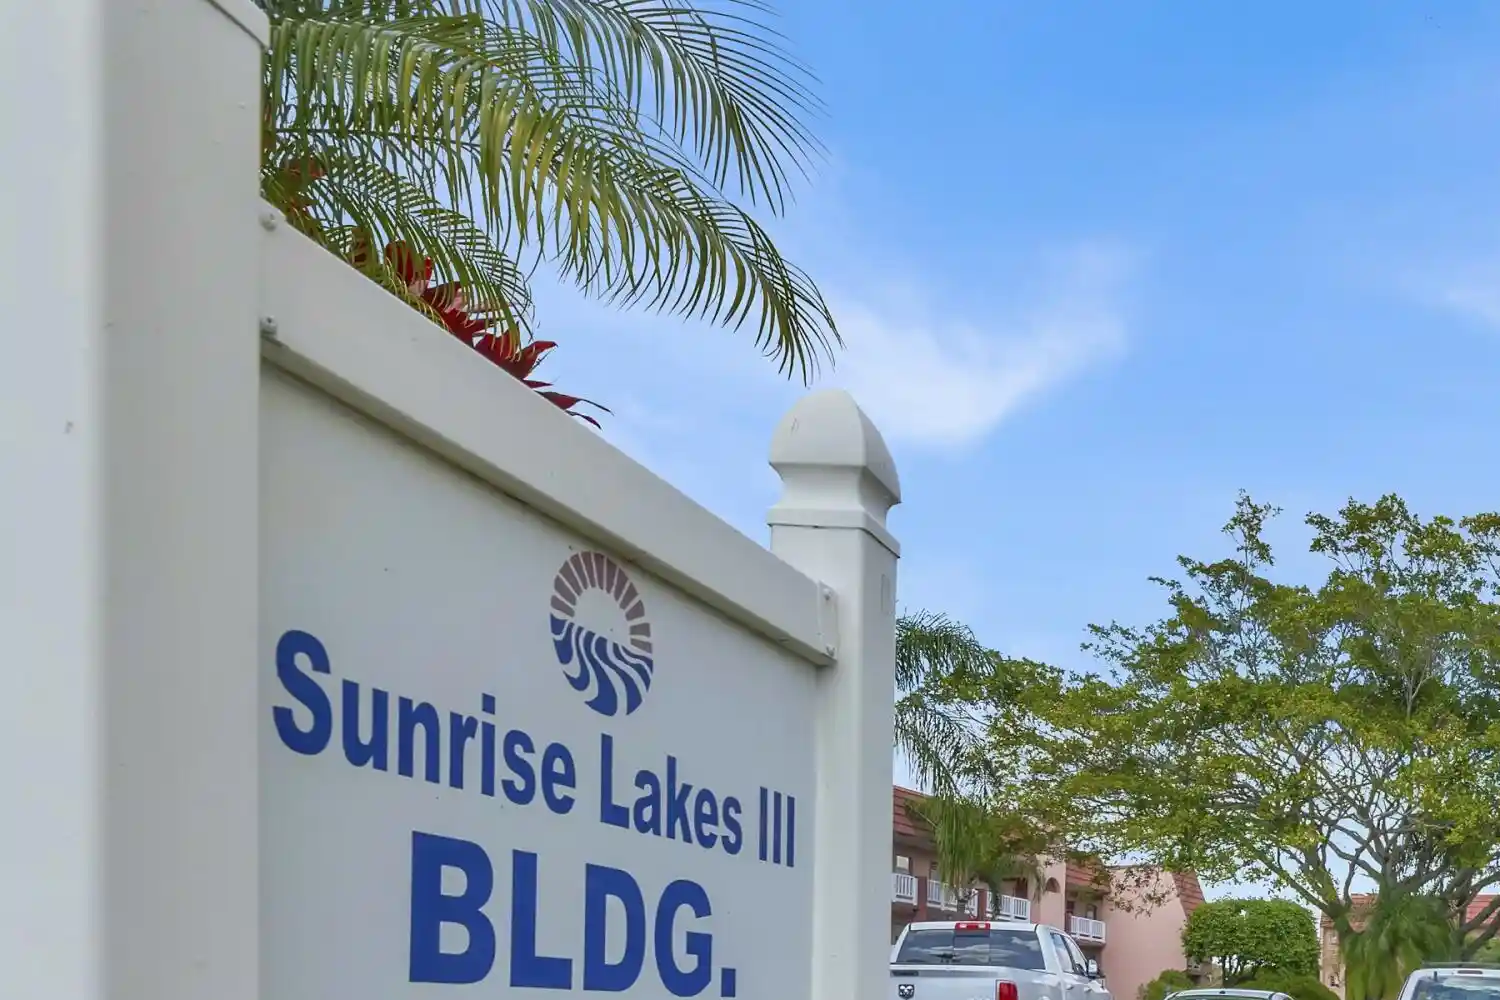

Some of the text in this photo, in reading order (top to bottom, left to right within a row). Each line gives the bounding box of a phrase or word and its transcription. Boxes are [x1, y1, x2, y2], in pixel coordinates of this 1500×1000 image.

[272, 630, 796, 867] Sunrise Lakes III
[408, 831, 737, 999] BLDG.
